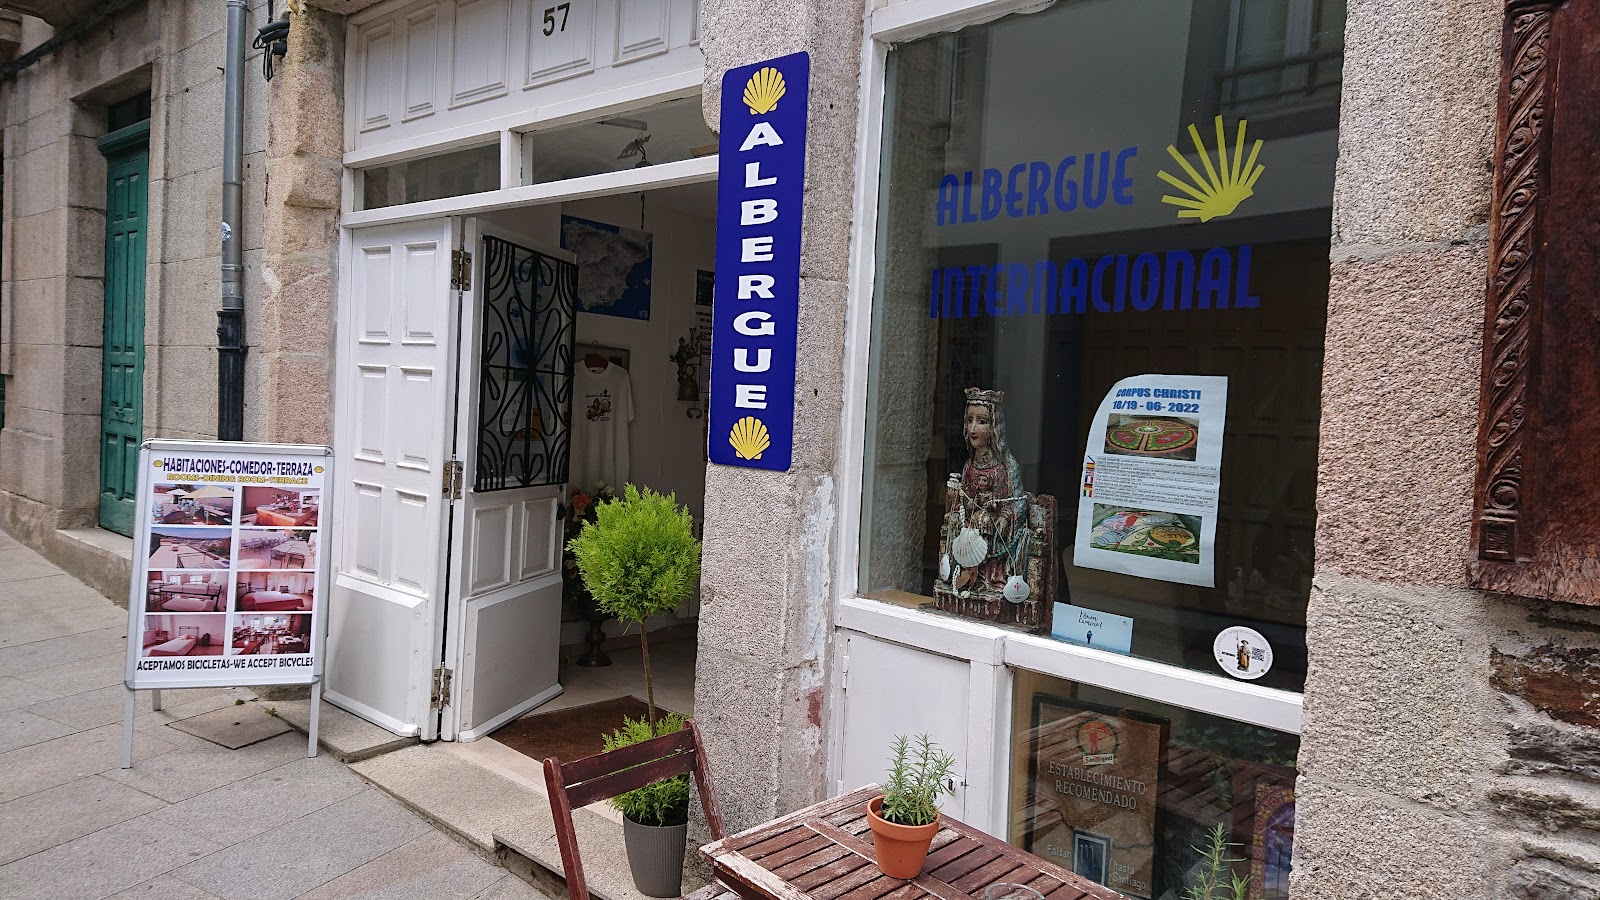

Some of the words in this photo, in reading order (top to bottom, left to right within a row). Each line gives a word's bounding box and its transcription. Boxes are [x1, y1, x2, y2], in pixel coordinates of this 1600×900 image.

[543, 2, 570, 36] 57
[936, 146, 1138, 226] ALBERGUE
[732, 121, 784, 410] ALBERGUE
[929, 243, 1262, 319] INTERNACIONAL
[1115, 388, 1151, 398] CORPUS
[1153, 388, 1202, 400] CHRISTI
[1113, 400, 1138, 410] 18/19
[1168, 402, 1200, 413] 2022
[137, 660, 186, 671] ACEPTAMOS
[247, 657, 278, 669] ACCEPT
[279, 656, 314, 668] BICYCLES
[1048, 761, 1147, 795] ESTABLECIMIENTO
[1055, 780, 1137, 810] RECOMENDADO
[1046, 844, 1072, 860] Faltan
[1113, 861, 1135, 874] hasta
[1112, 873, 1146, 891] Santiago
